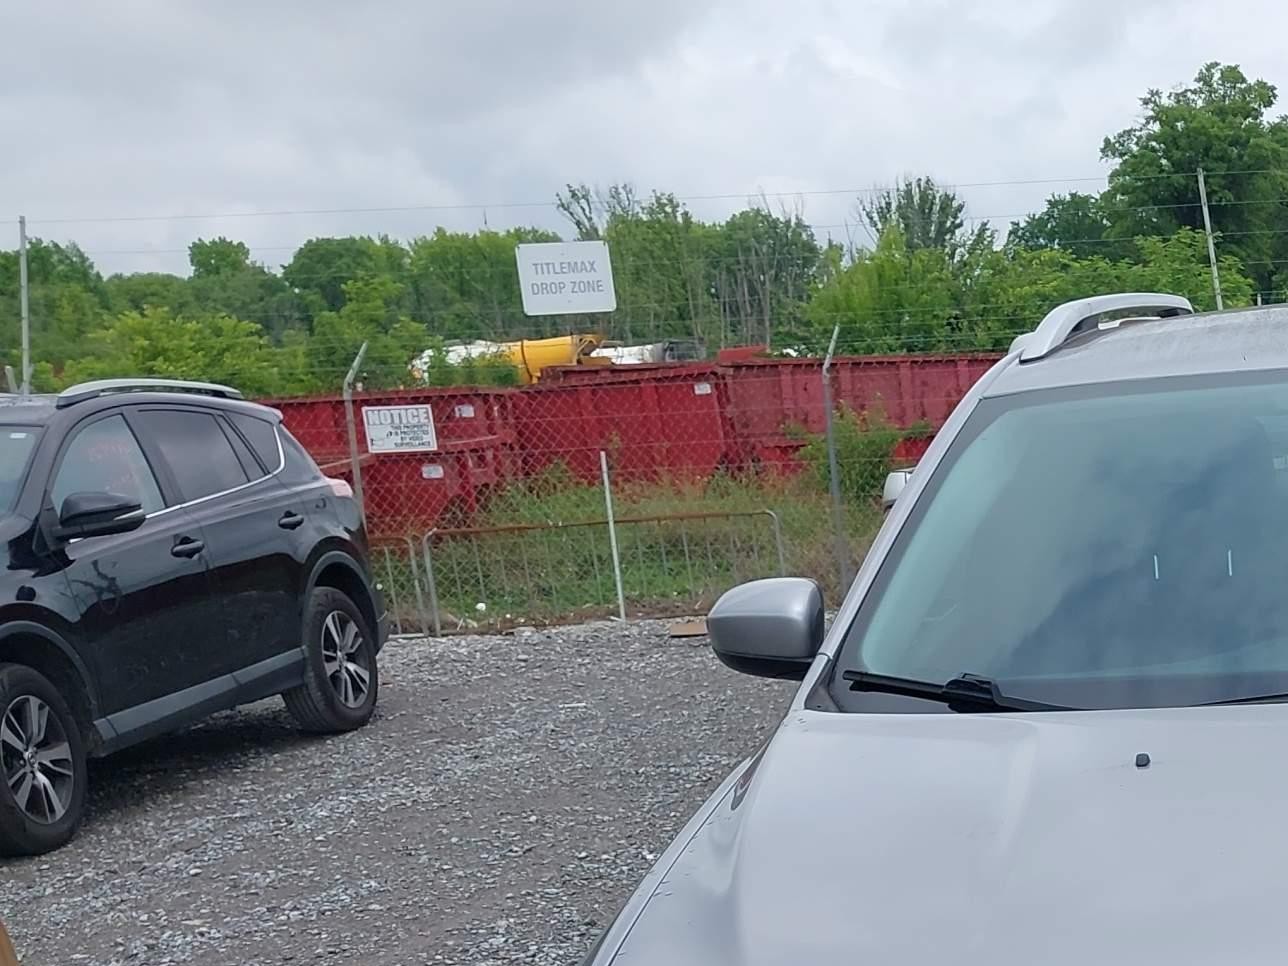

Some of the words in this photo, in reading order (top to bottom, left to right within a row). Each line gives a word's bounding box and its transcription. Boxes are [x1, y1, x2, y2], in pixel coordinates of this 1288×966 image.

[532, 260, 598, 276] TITLEMAX
[530, 281, 567, 296] DROP
[569, 279, 605, 294] ZONE
[367, 409, 430, 426] NOTICE
